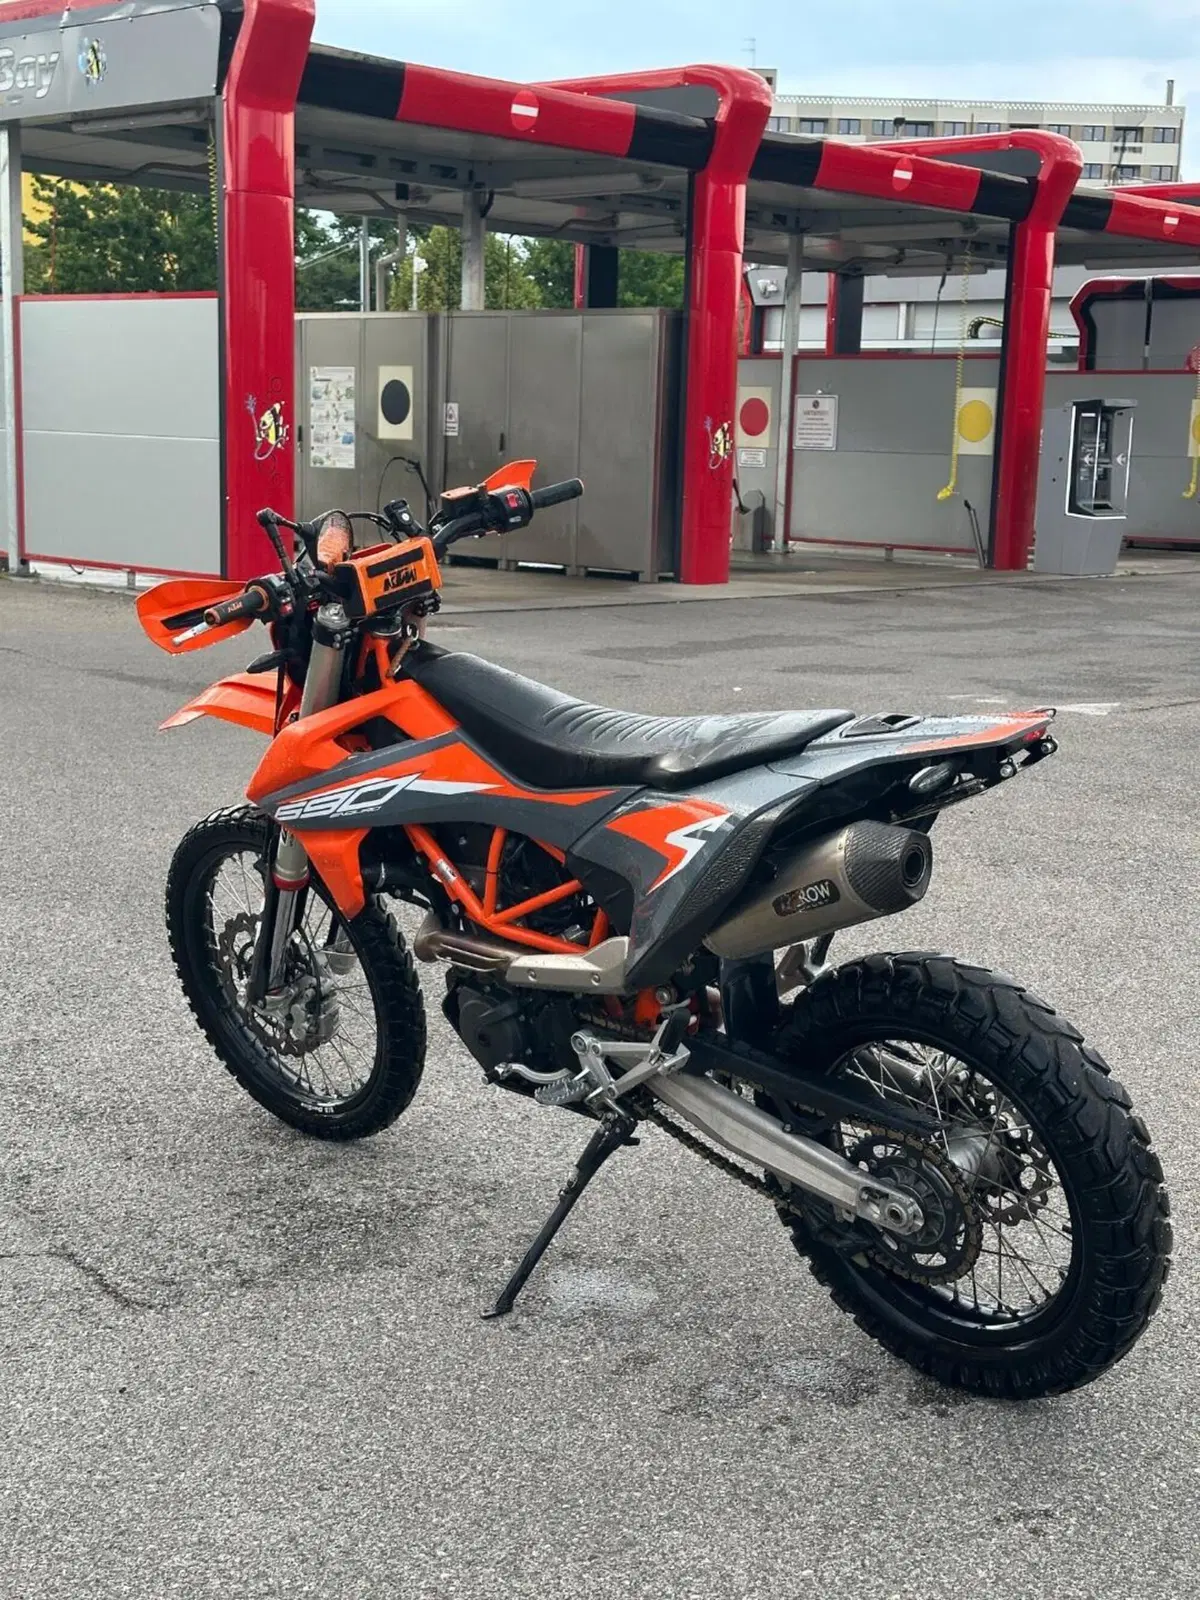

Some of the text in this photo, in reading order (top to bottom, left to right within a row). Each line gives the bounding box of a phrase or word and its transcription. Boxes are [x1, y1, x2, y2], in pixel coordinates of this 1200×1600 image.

[383, 566, 418, 592] KTM
[274, 772, 422, 821] 690
[779, 881, 831, 912] ROW
